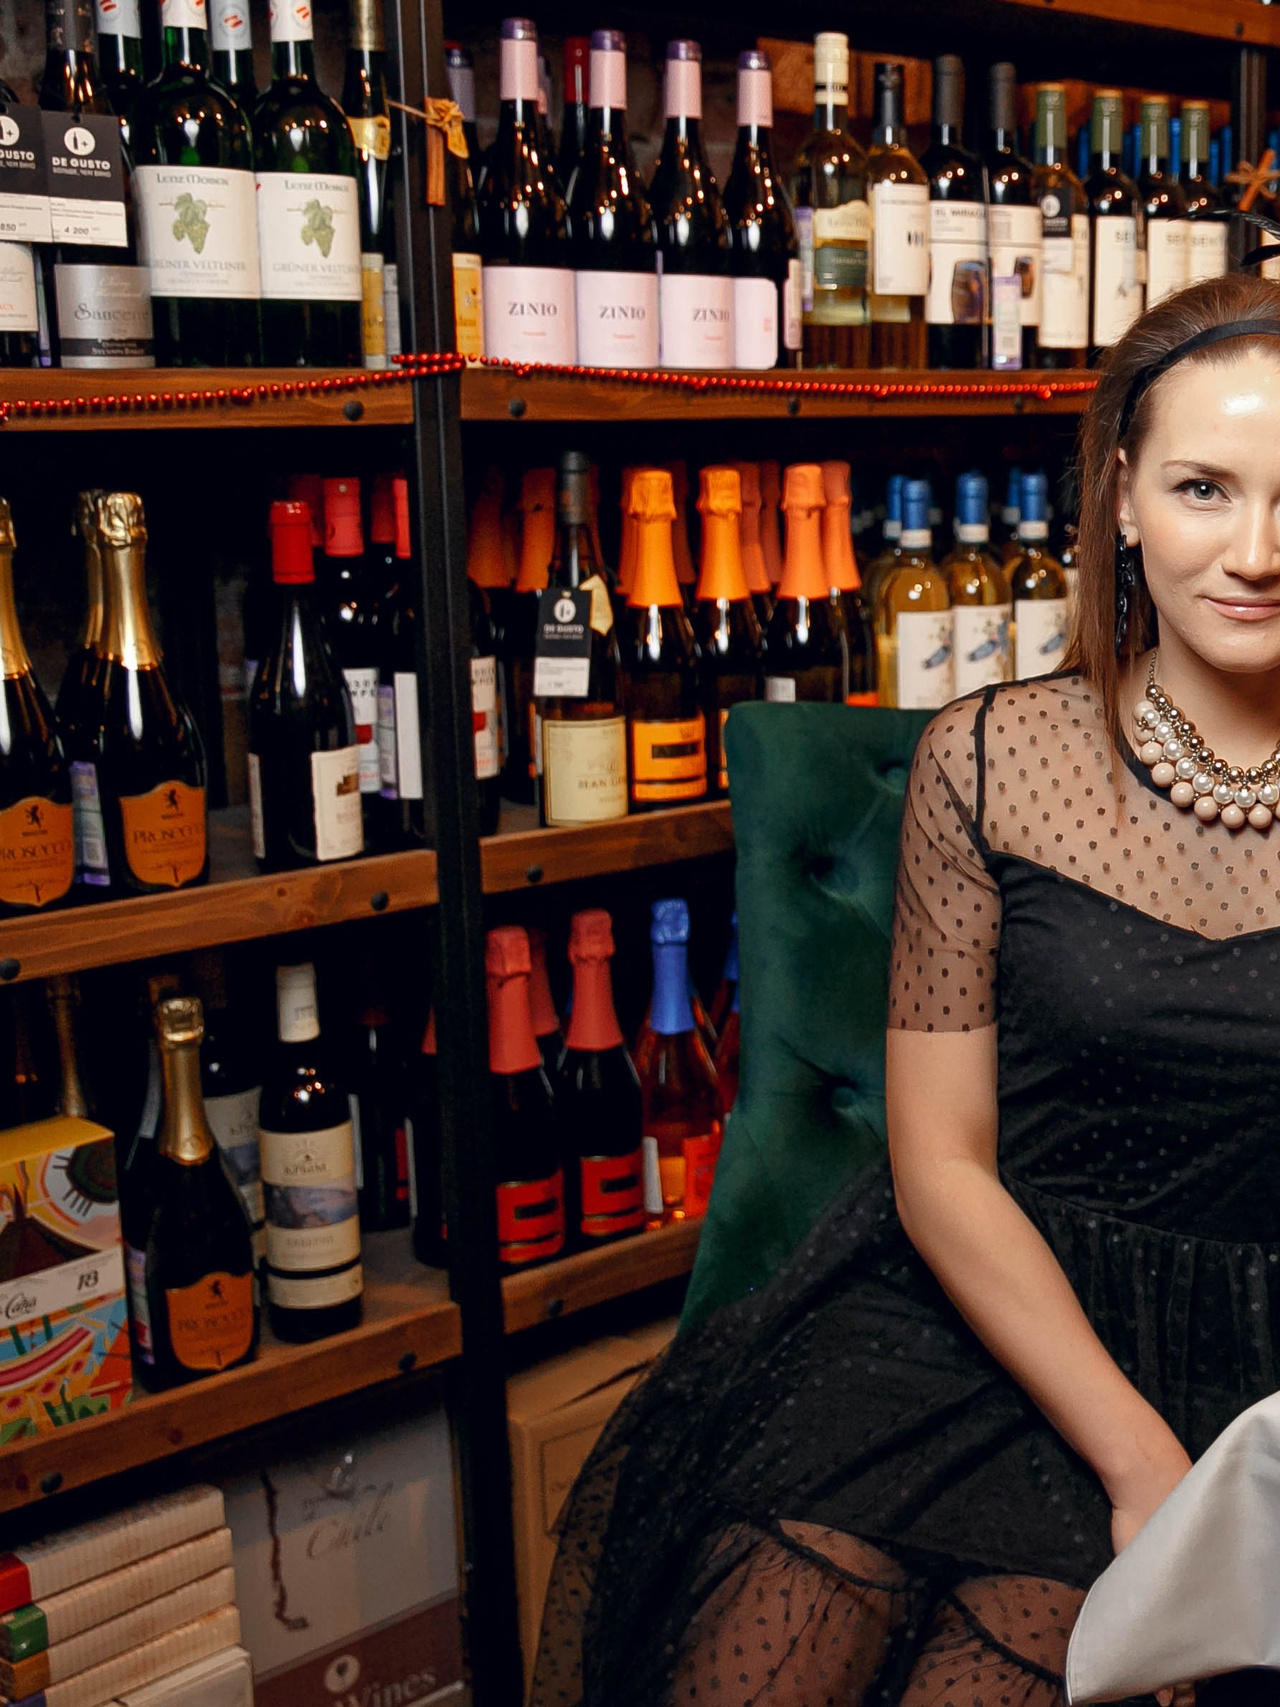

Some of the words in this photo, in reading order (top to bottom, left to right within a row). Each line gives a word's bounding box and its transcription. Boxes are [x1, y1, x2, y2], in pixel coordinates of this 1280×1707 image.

[52, 156, 68, 167] DE
[70, 158, 111, 170] GUSTO
[508, 302, 557, 316] ZINIO
[599, 306, 646, 320] ZINIO
[693, 308, 730, 322] ZINIO
